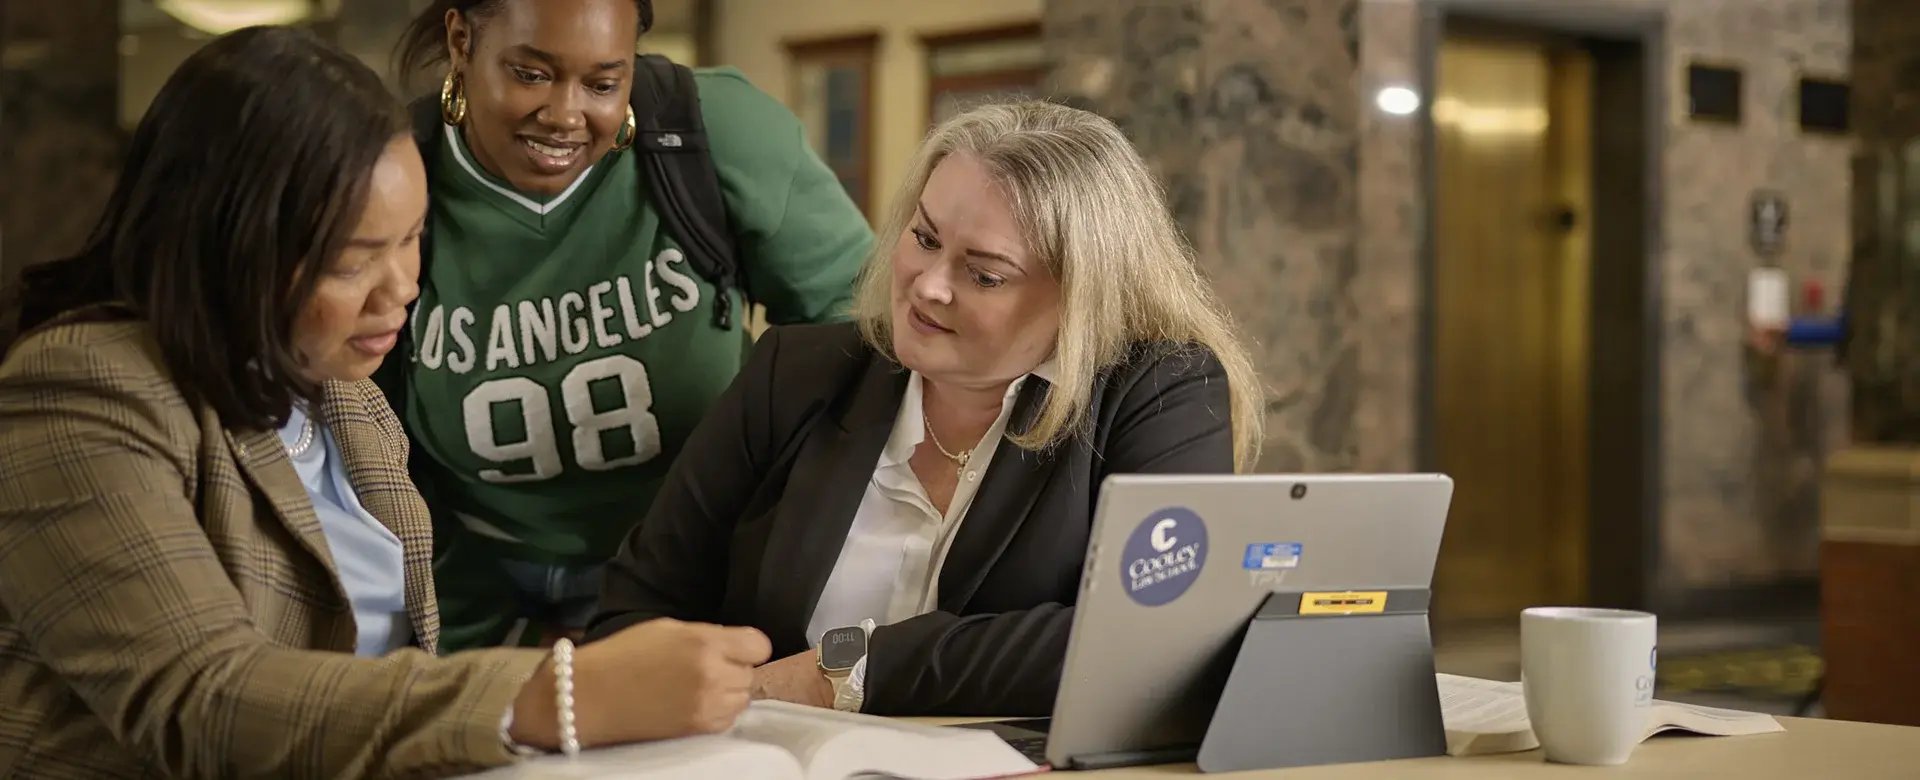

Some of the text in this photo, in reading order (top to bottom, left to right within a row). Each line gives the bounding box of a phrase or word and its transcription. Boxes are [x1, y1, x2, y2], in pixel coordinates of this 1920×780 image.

[486, 248, 699, 371] ANGELES
[463, 354, 661, 481] 98
[1151, 518, 1177, 553] C
